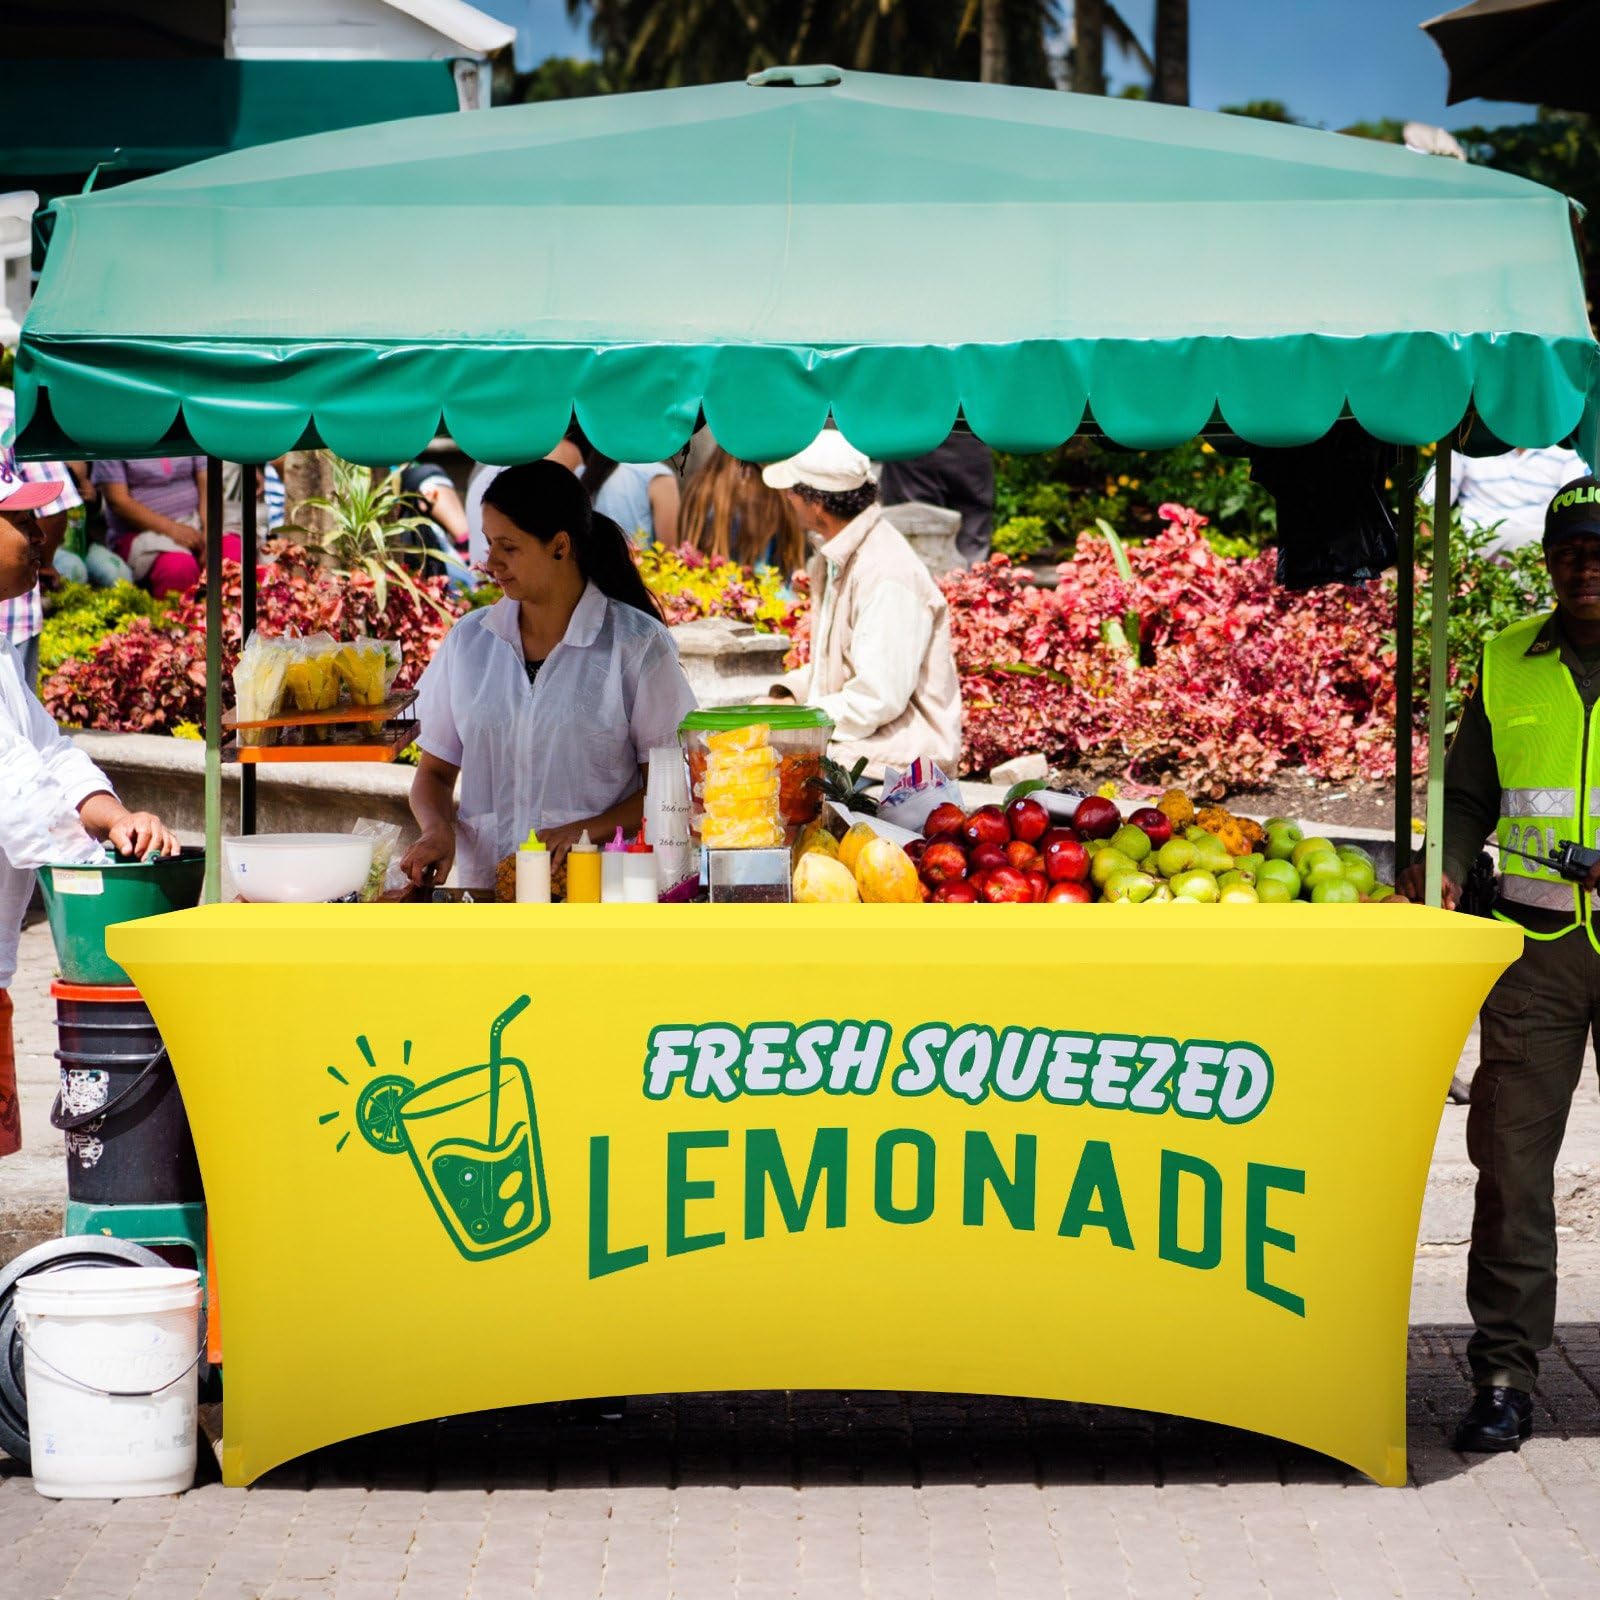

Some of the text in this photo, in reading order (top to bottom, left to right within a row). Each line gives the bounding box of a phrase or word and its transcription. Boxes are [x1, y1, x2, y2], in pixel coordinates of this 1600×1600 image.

[661, 804, 676, 813] 266
[659, 838, 674, 847] 266
[643, 1020, 1274, 1125] FRESH SQUEEZED
[589, 1128, 1305, 1318] LEMONADE
